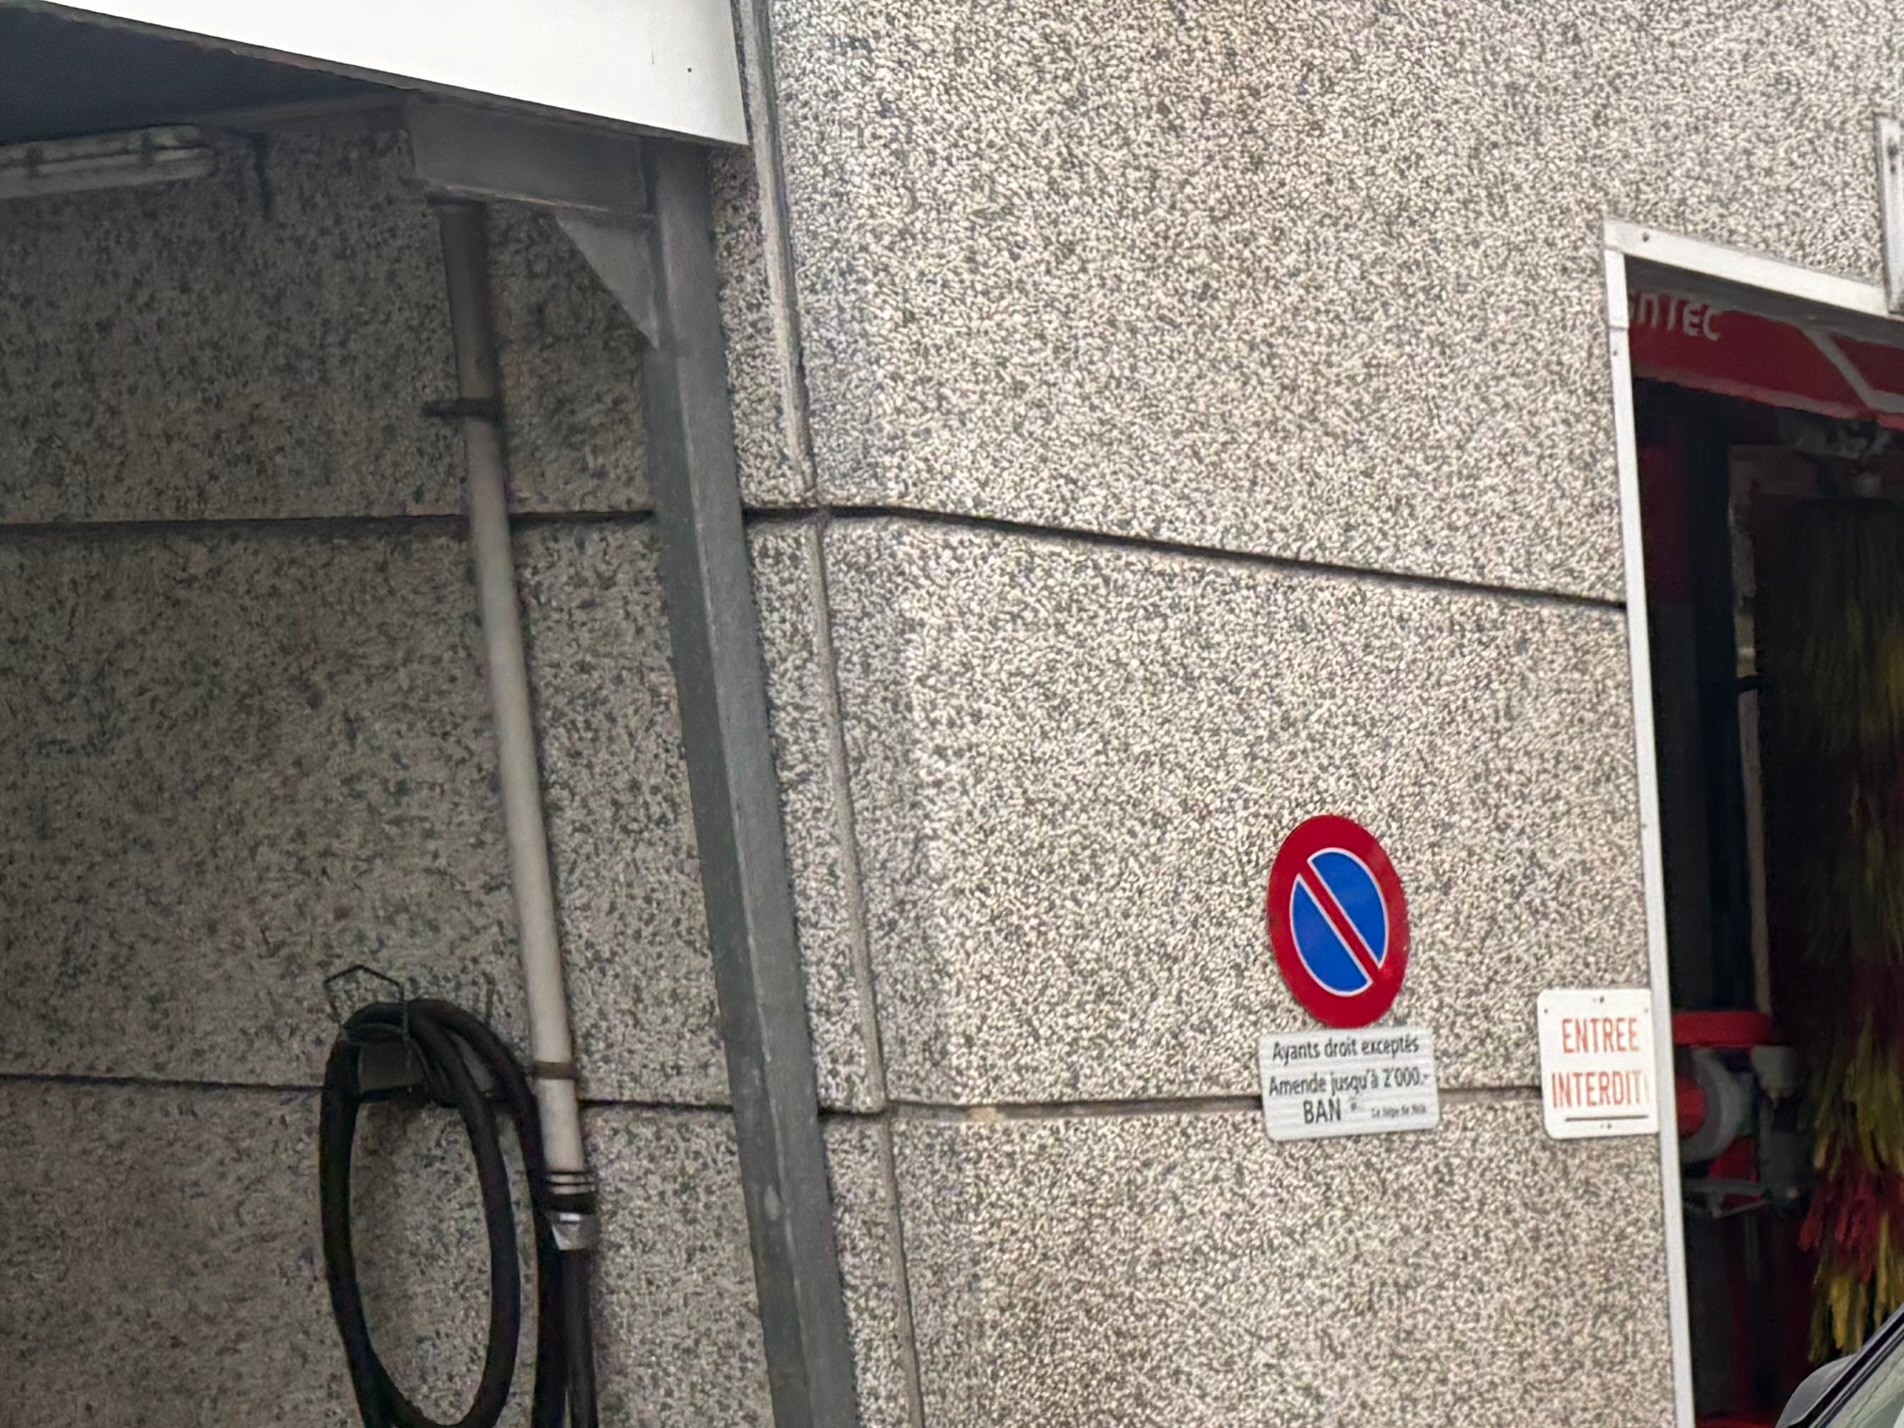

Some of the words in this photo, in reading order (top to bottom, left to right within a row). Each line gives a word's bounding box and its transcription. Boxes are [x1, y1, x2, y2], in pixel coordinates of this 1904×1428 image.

[1272, 1040, 1321, 1066] Ayants
[1324, 1036, 1358, 1058] droit
[1361, 1033, 1420, 1059] exceptés
[1562, 1017, 1640, 1053] ENTREE
[1269, 1073, 1327, 1097] Amende
[1329, 1069, 1379, 1096] jusqu'à
[1303, 1098, 1341, 1124] BAN
